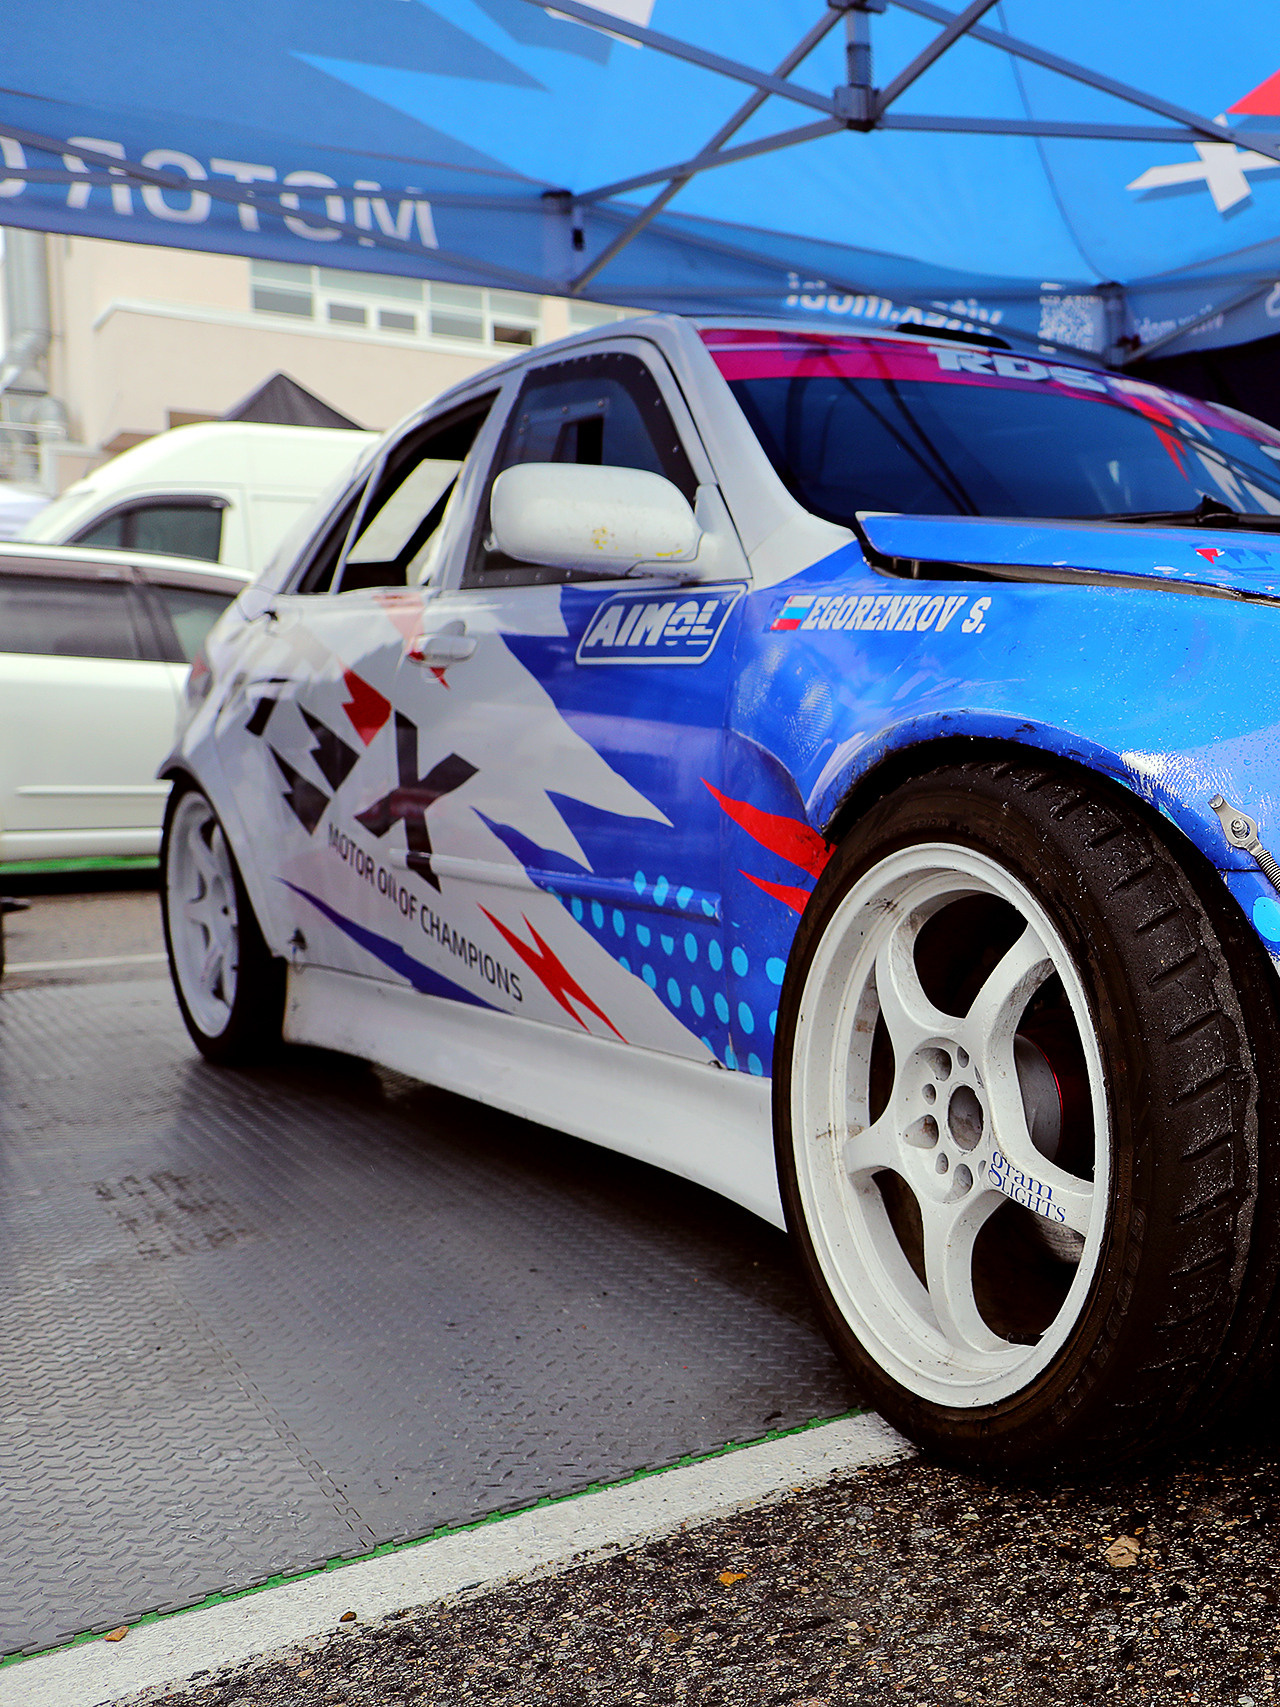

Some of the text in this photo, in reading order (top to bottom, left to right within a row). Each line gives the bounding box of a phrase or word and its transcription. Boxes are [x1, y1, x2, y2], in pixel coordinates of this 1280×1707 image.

[927, 346, 1108, 393] RDS
[801, 595, 993, 634] EGORENKOV S.
[328, 821, 524, 1003] MOTOR OIL OF CHAMPIONS
[987, 1151, 1054, 1202] gram
[1001, 1176, 1067, 1223] LIGHTS
